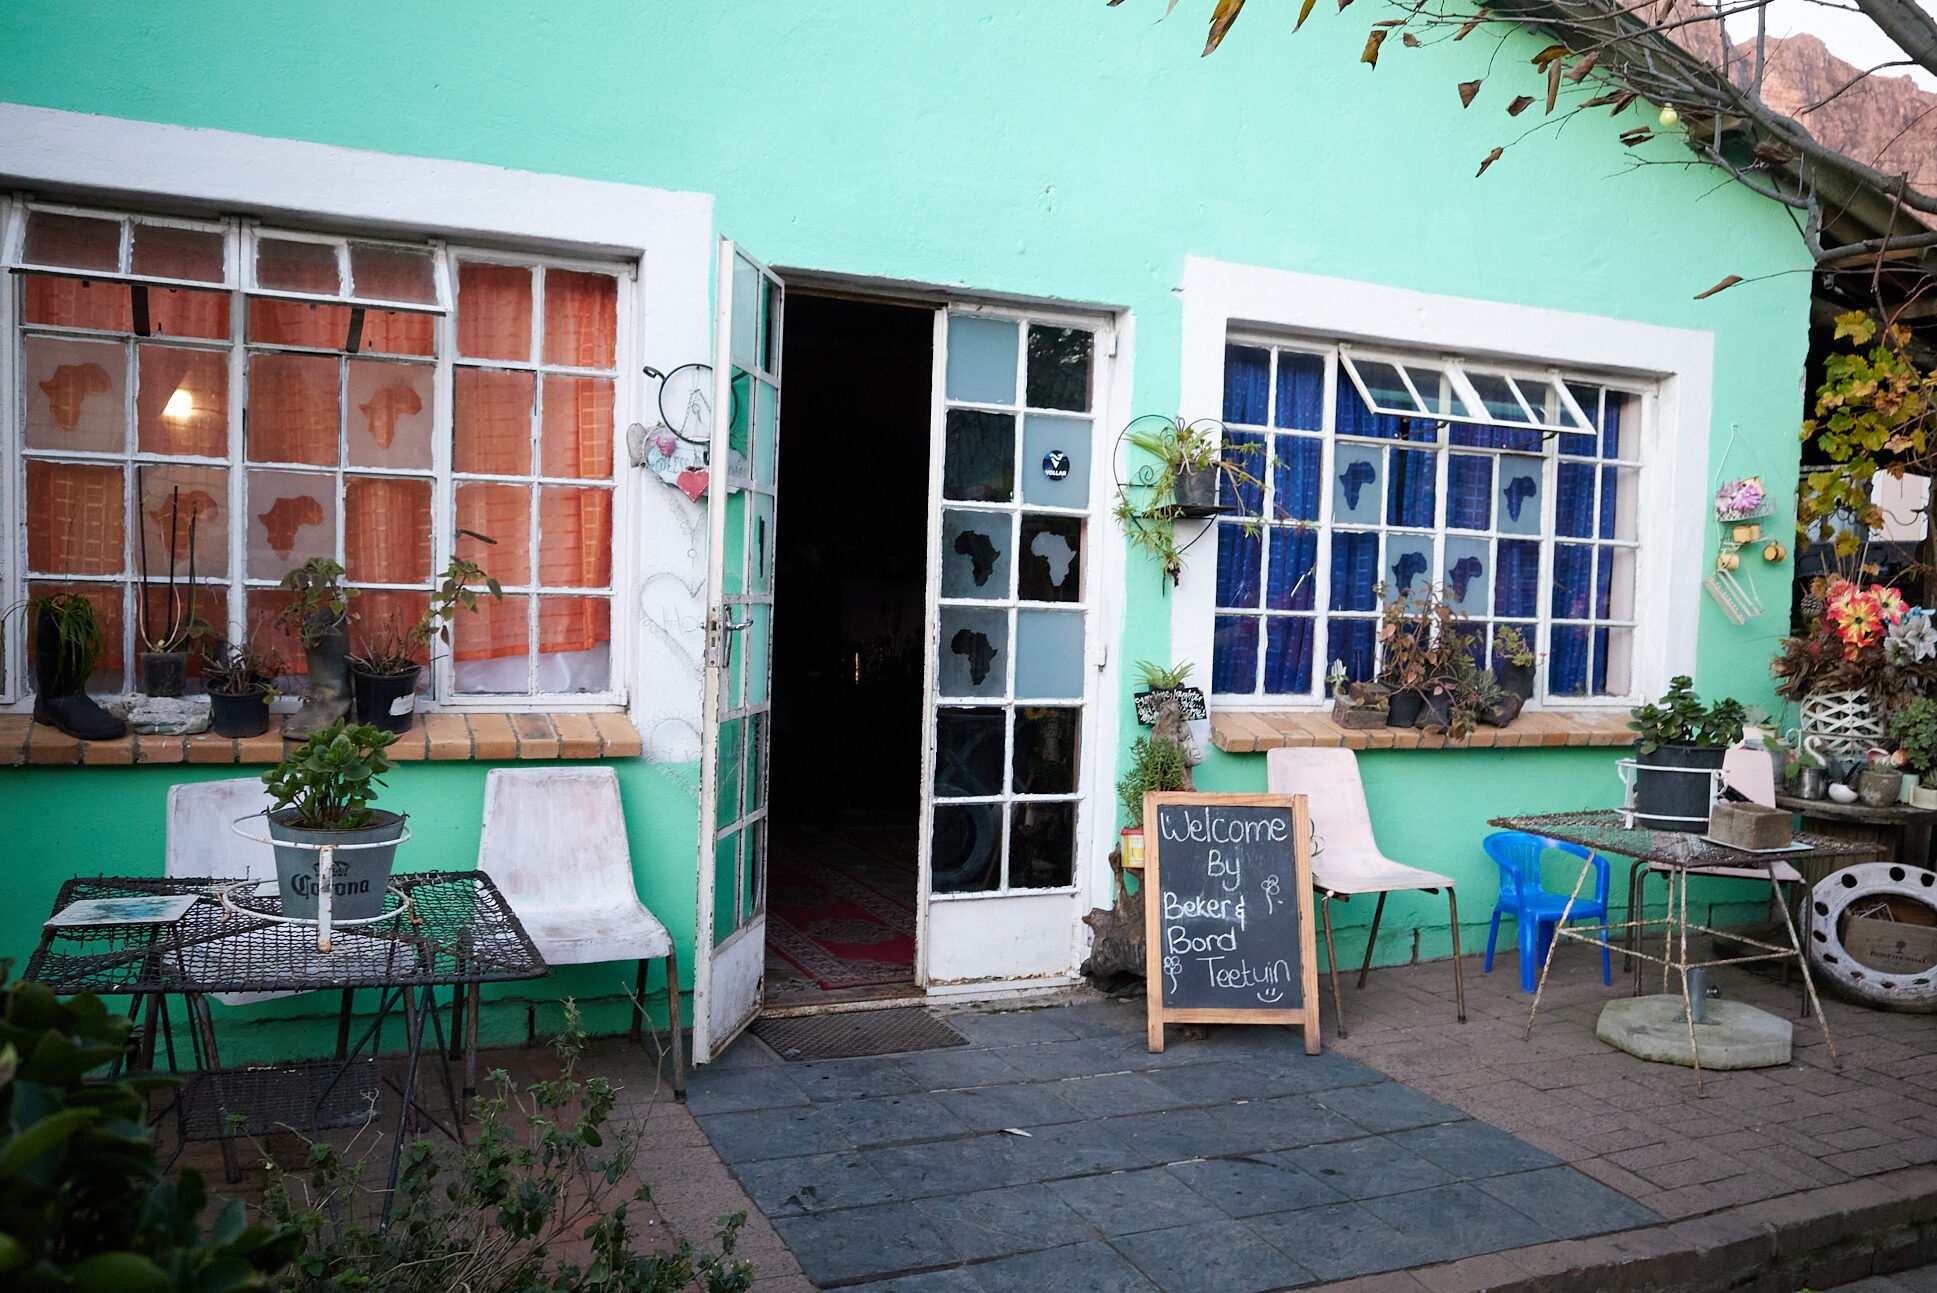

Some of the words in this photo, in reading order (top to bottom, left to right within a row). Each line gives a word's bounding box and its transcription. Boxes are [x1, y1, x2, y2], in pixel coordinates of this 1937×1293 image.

[1160, 807, 1288, 843] Welcome
[290, 873, 369, 899] Coona
[1207, 849, 1241, 892] By
[1163, 891, 1232, 920] Beker
[1234, 895, 1246, 932] &
[1167, 926, 1238, 955] Bord
[1195, 955, 1291, 988] Teetuin
